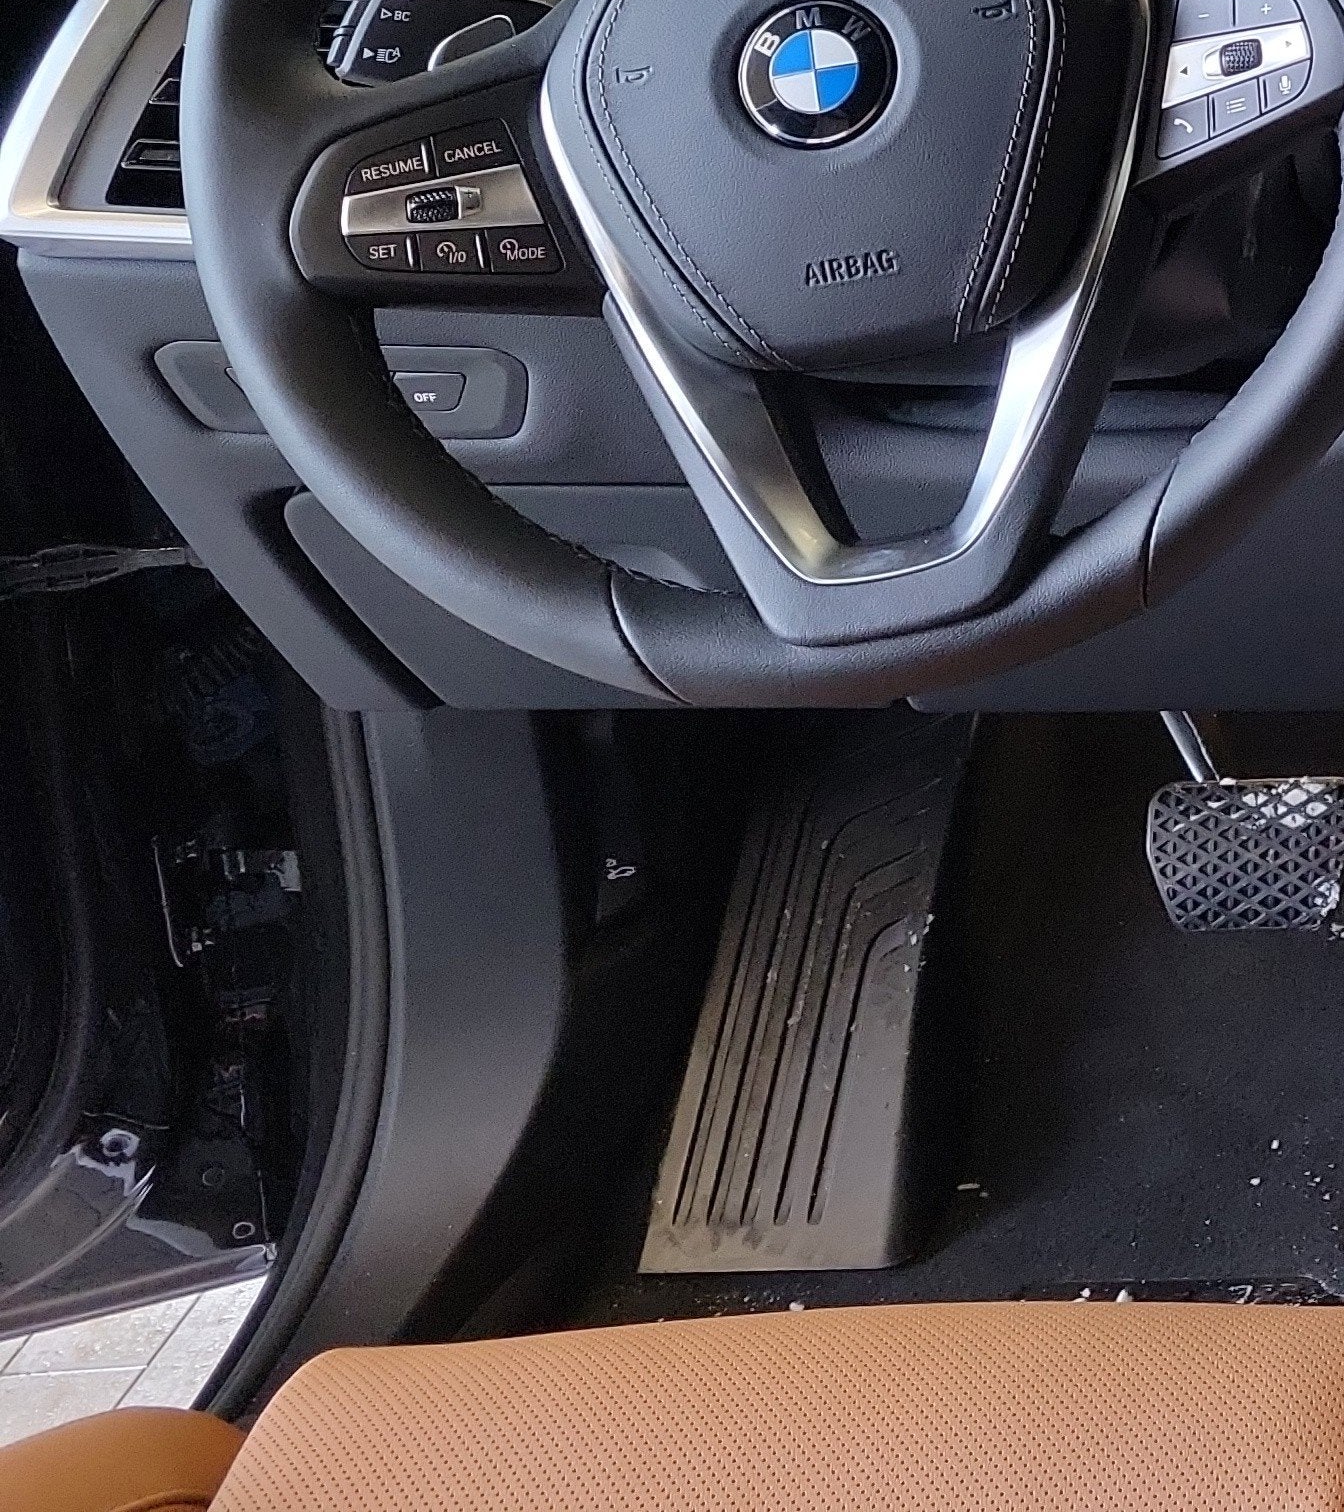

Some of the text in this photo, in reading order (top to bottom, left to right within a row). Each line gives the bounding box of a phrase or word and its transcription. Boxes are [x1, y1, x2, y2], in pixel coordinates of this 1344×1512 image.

[393, 10, 411, 22] BC
[754, 6, 871, 60] BMW
[444, 140, 502, 163] CANCEL
[361, 156, 424, 182] RESUME
[369, 244, 398, 260] SET
[506, 246, 547, 261] MODE
[804, 249, 898, 287] AIRBAG
[413, 391, 437, 403] OFF
